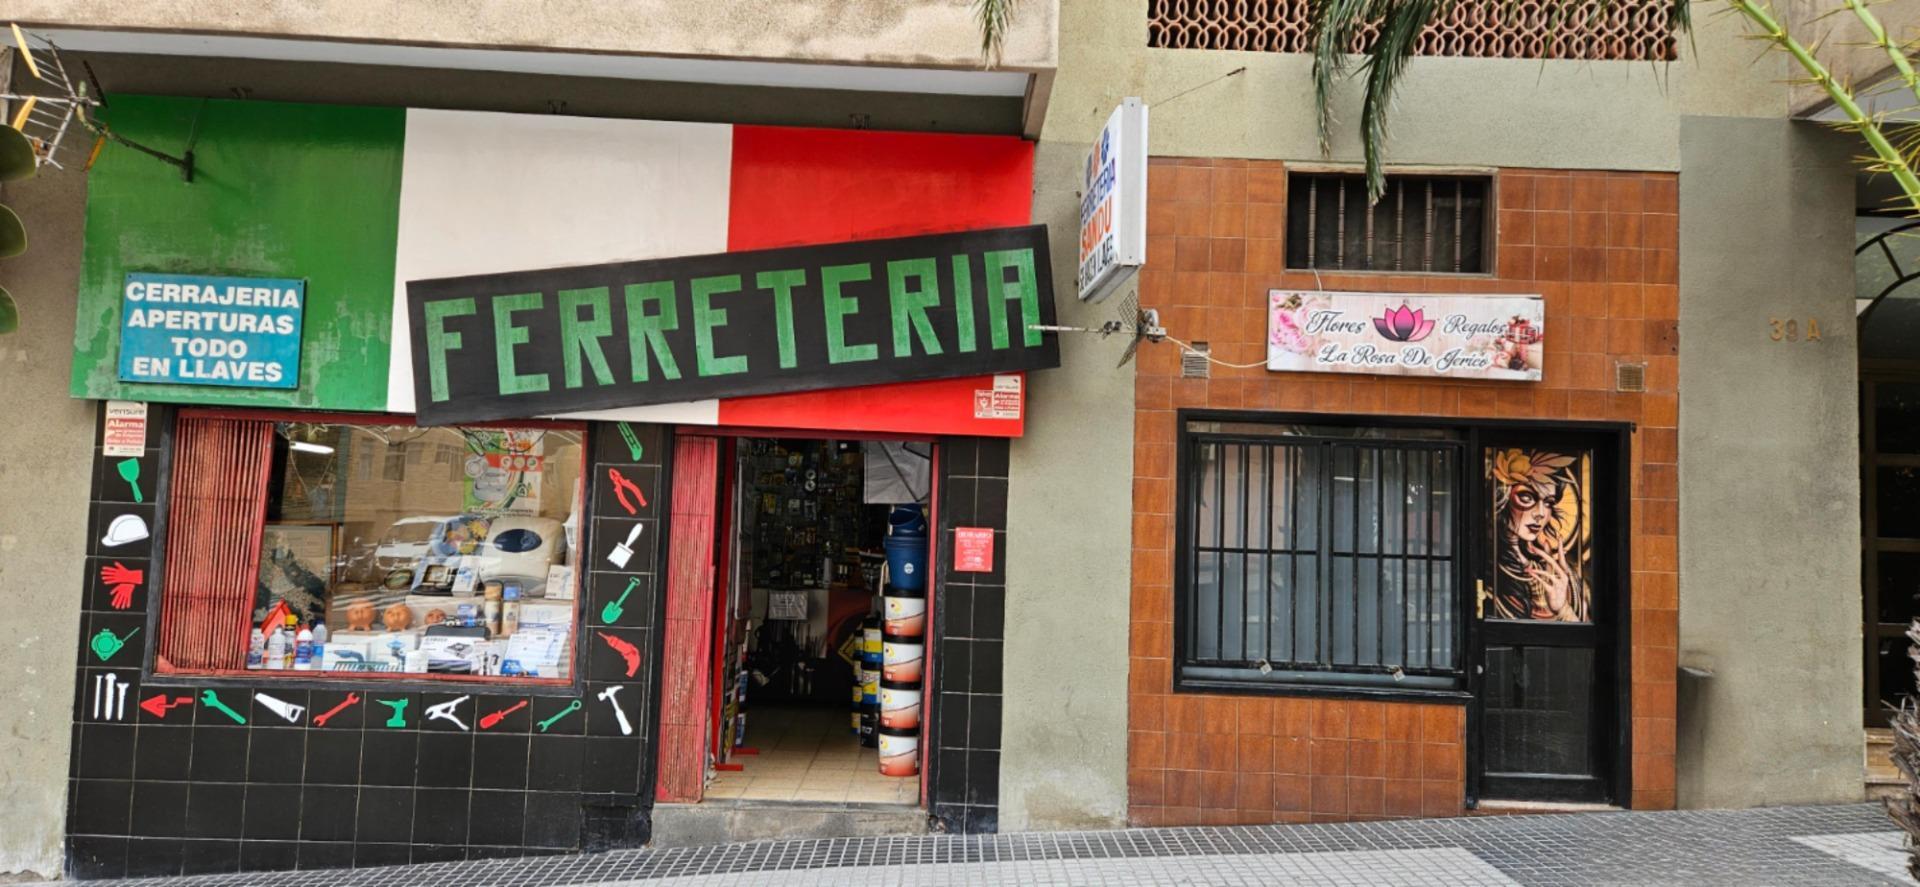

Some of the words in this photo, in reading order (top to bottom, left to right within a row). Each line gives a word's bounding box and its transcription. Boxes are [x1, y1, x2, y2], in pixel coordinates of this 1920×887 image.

[1081, 157, 1115, 224] FERRETERIA
[1081, 195, 1112, 262] SANDU
[126, 281, 299, 308] CERRAJERIA
[128, 309, 294, 335] APERTURAS
[424, 248, 1042, 402] FERRETERIA
[1306, 310, 1366, 334] Flores
[1443, 314, 1507, 340] Regalos
[1807, 318, 1823, 342] A
[172, 337, 248, 359] TODO
[1319, 344, 1347, 362] La
[1351, 345, 1396, 364] Rosa
[1402, 347, 1432, 365] De
[133, 357, 170, 377] EN
[179, 359, 283, 382] LLAVES
[108, 419, 144, 429] Alarma
